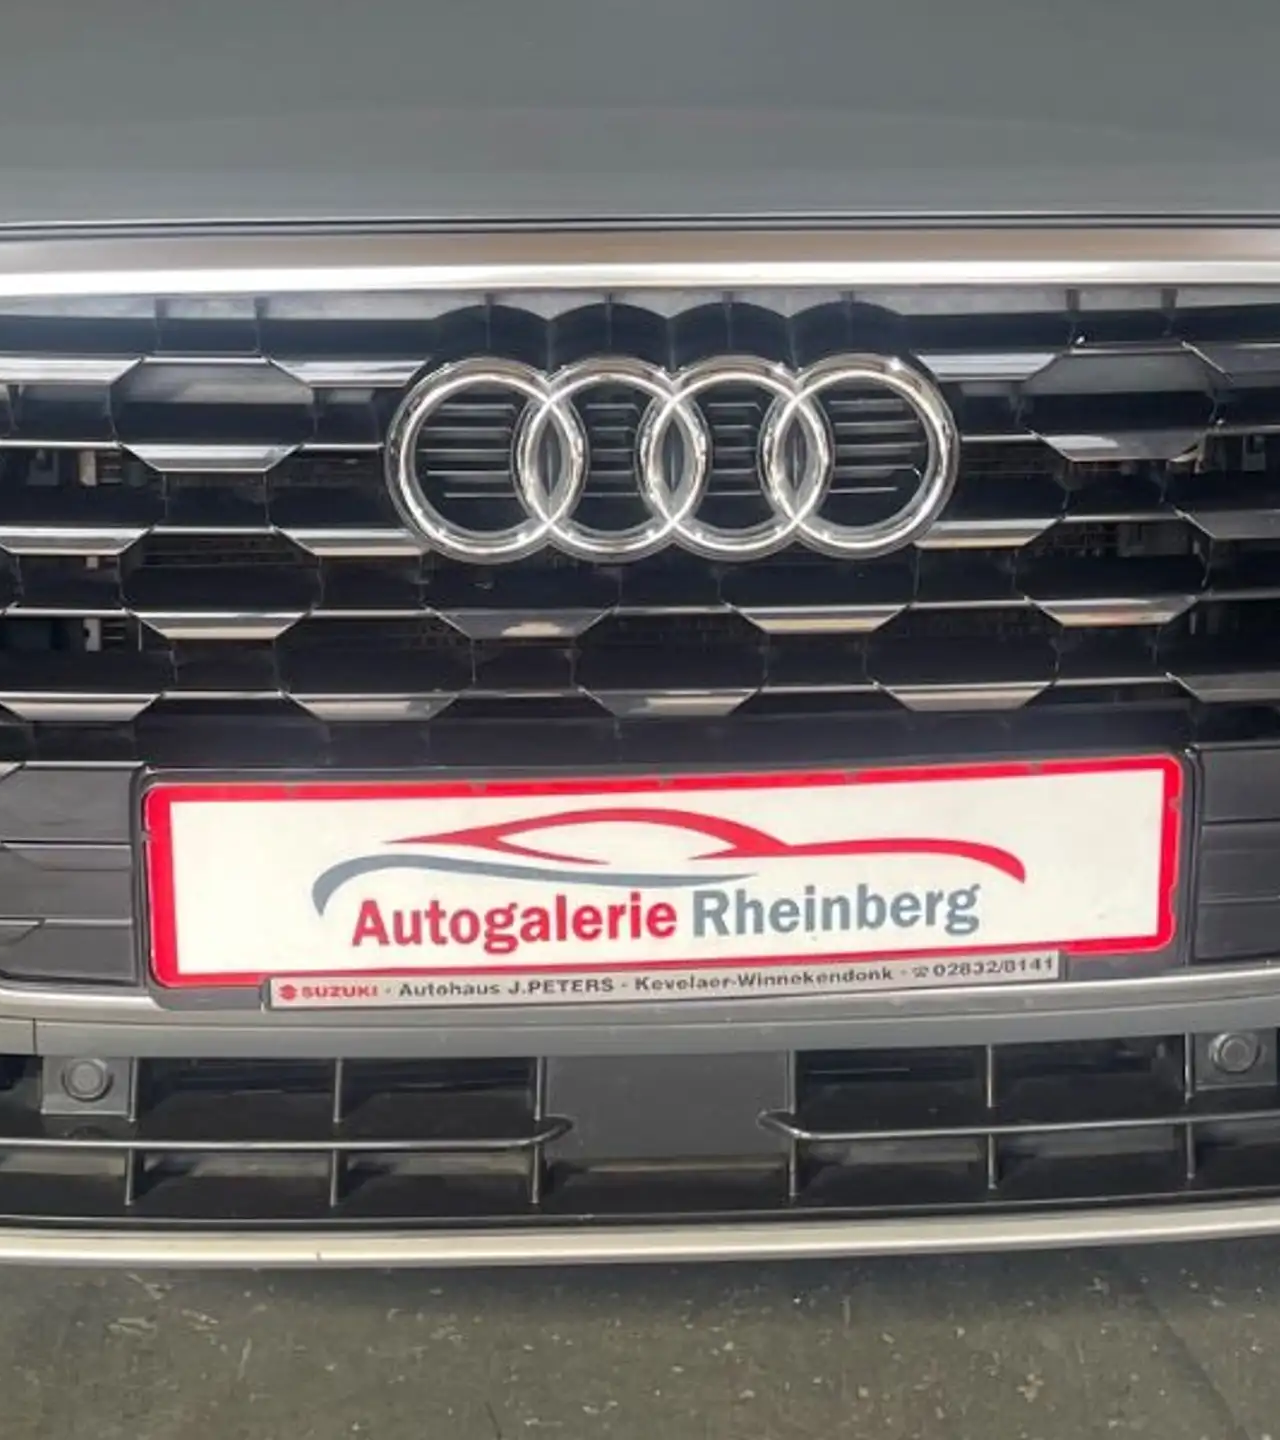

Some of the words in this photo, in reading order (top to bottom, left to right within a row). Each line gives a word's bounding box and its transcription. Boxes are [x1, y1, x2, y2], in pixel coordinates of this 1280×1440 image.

[351, 890, 678, 954] Autogalerie
[691, 882, 981, 936] Rheinberg
[301, 984, 378, 1000] SUZUKI
[398, 981, 501, 998] Autohaus
[506, 976, 615, 996] J.PETERS
[633, 966, 894, 992] Kevelaer-Winnekendonk
